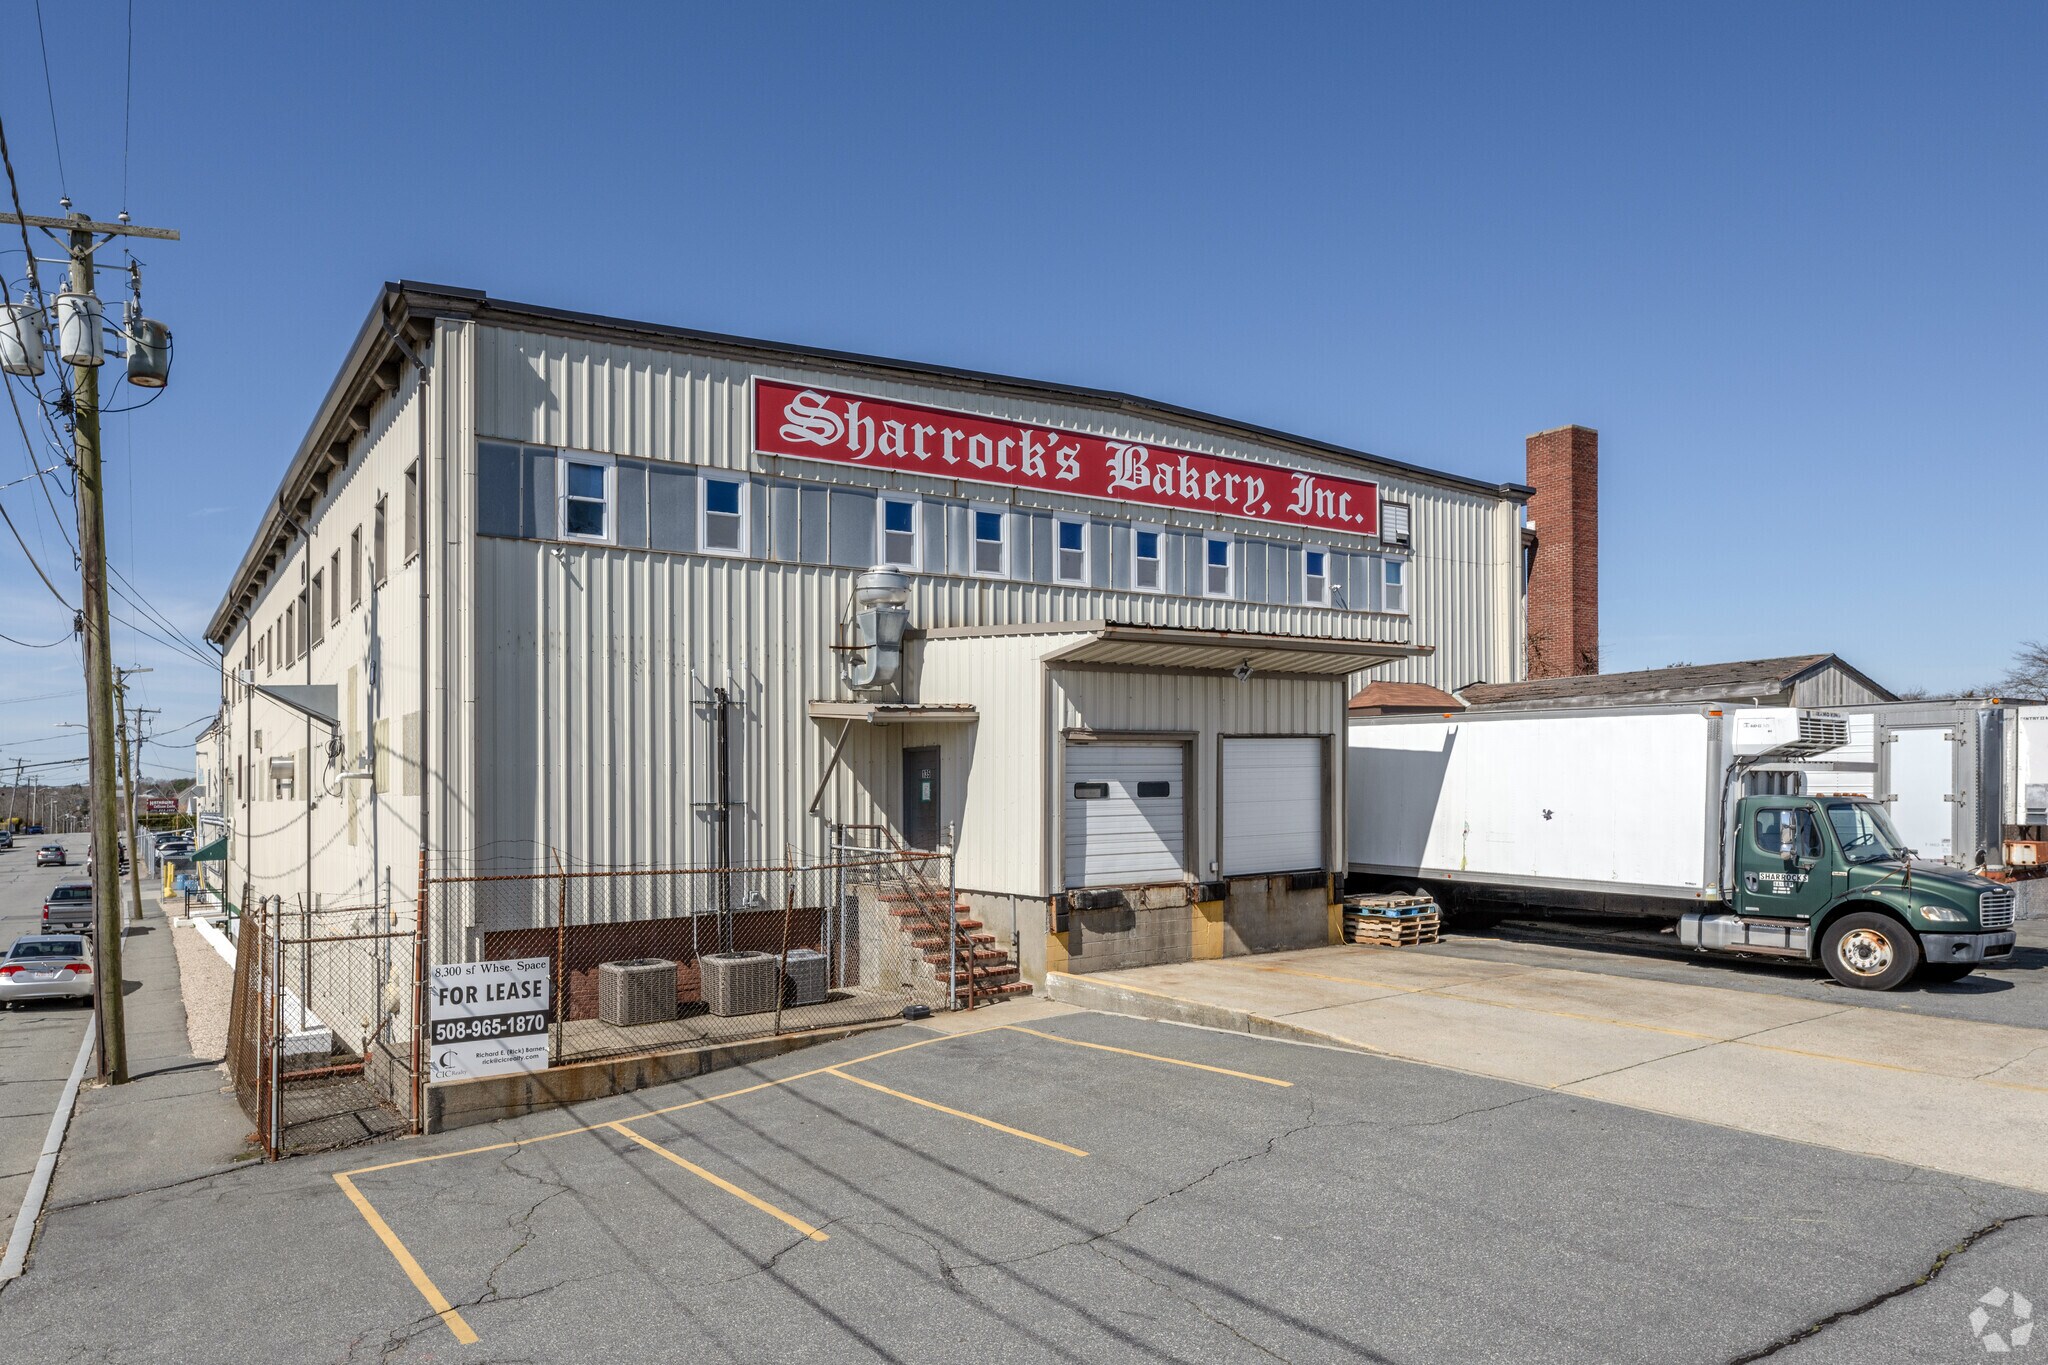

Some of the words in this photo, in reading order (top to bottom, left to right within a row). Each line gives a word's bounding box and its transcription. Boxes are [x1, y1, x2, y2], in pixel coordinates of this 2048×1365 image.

[779, 389, 1081, 482] Sharrock's
[1105, 441, 1272, 516] Bakery,
[1286, 471, 1364, 524] Inc.
[465, 965, 477, 975] sf
[481, 963, 513, 973] Whse.
[517, 961, 546, 971] Space
[439, 986, 478, 1006] FOR
[486, 979, 542, 1002] LEASE
[435, 1014, 545, 1041] 508-965-1870
[476, 1051, 499, 1059] Richard
[507, 1048, 525, 1057] (Rick)
[435, 1070, 452, 1079] CIC
